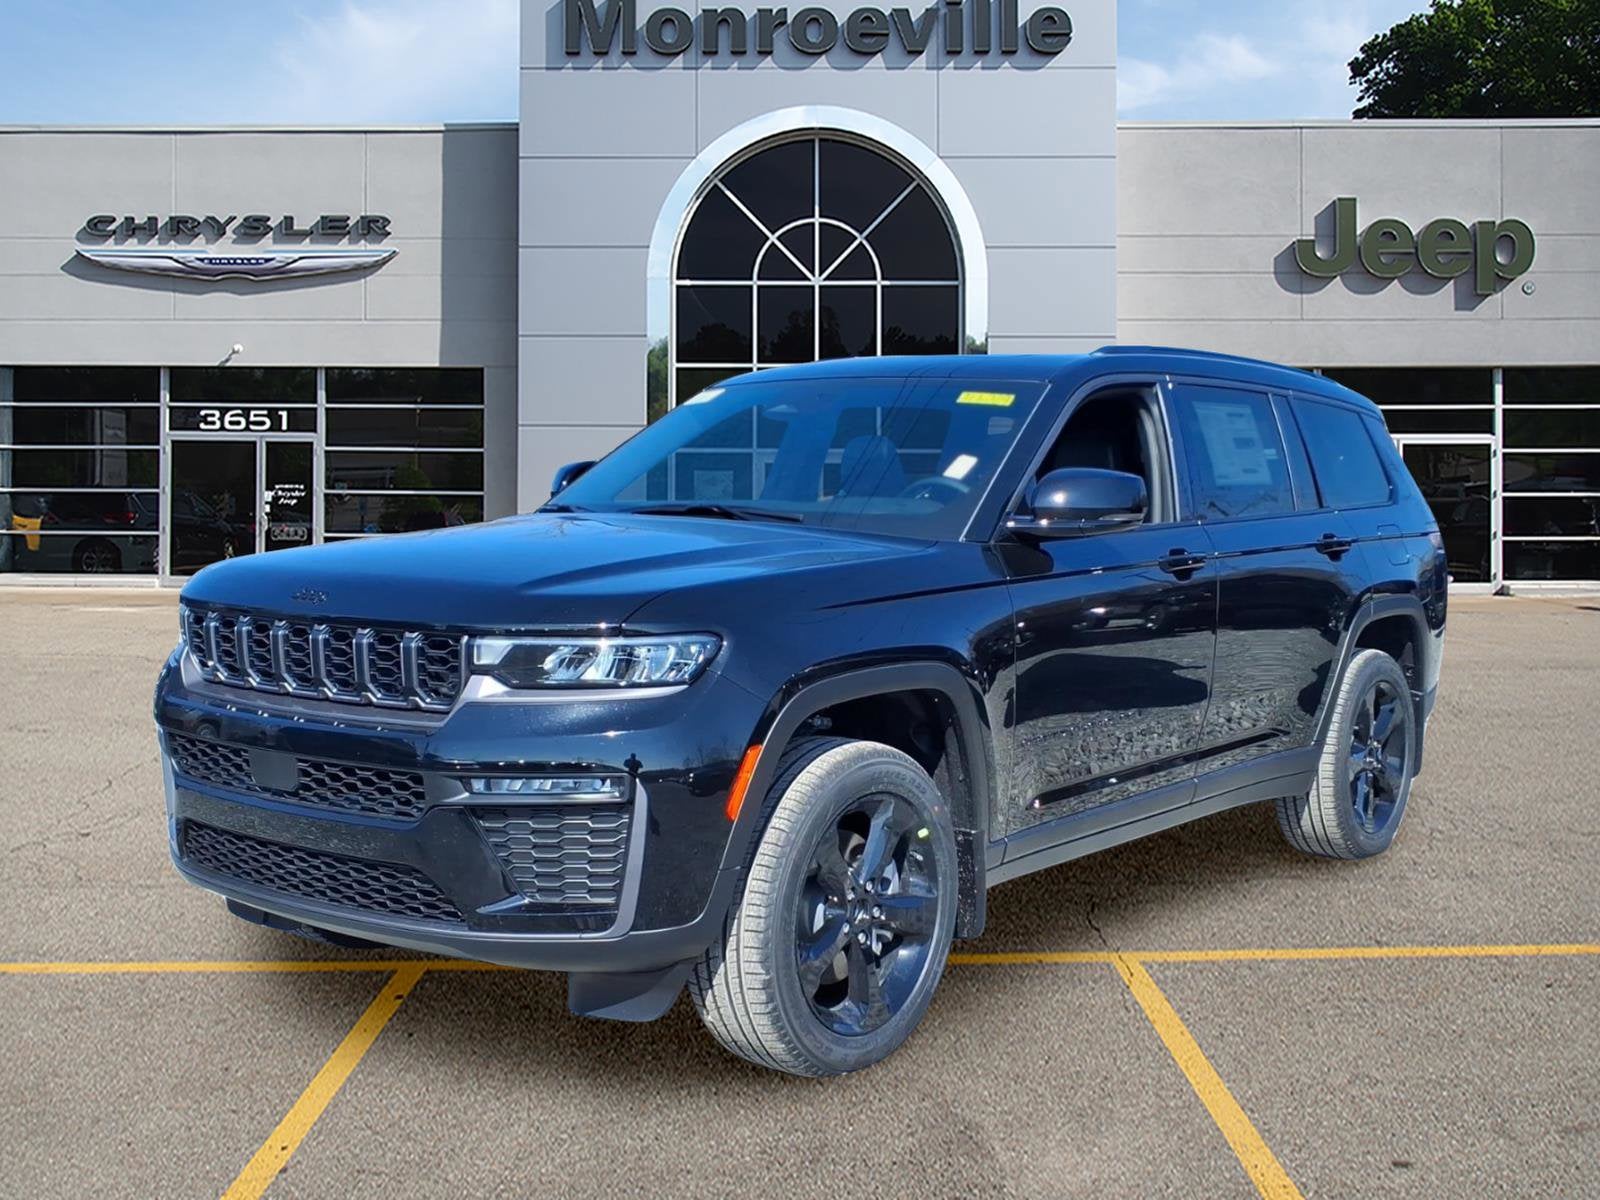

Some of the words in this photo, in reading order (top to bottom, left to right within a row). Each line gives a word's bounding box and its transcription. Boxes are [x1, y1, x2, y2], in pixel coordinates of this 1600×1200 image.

[564, 0, 1073, 54] Monroeville
[86, 215, 392, 236] CHRYSLER
[1295, 197, 1535, 295] Jeep
[199, 410, 288, 431] 3651
